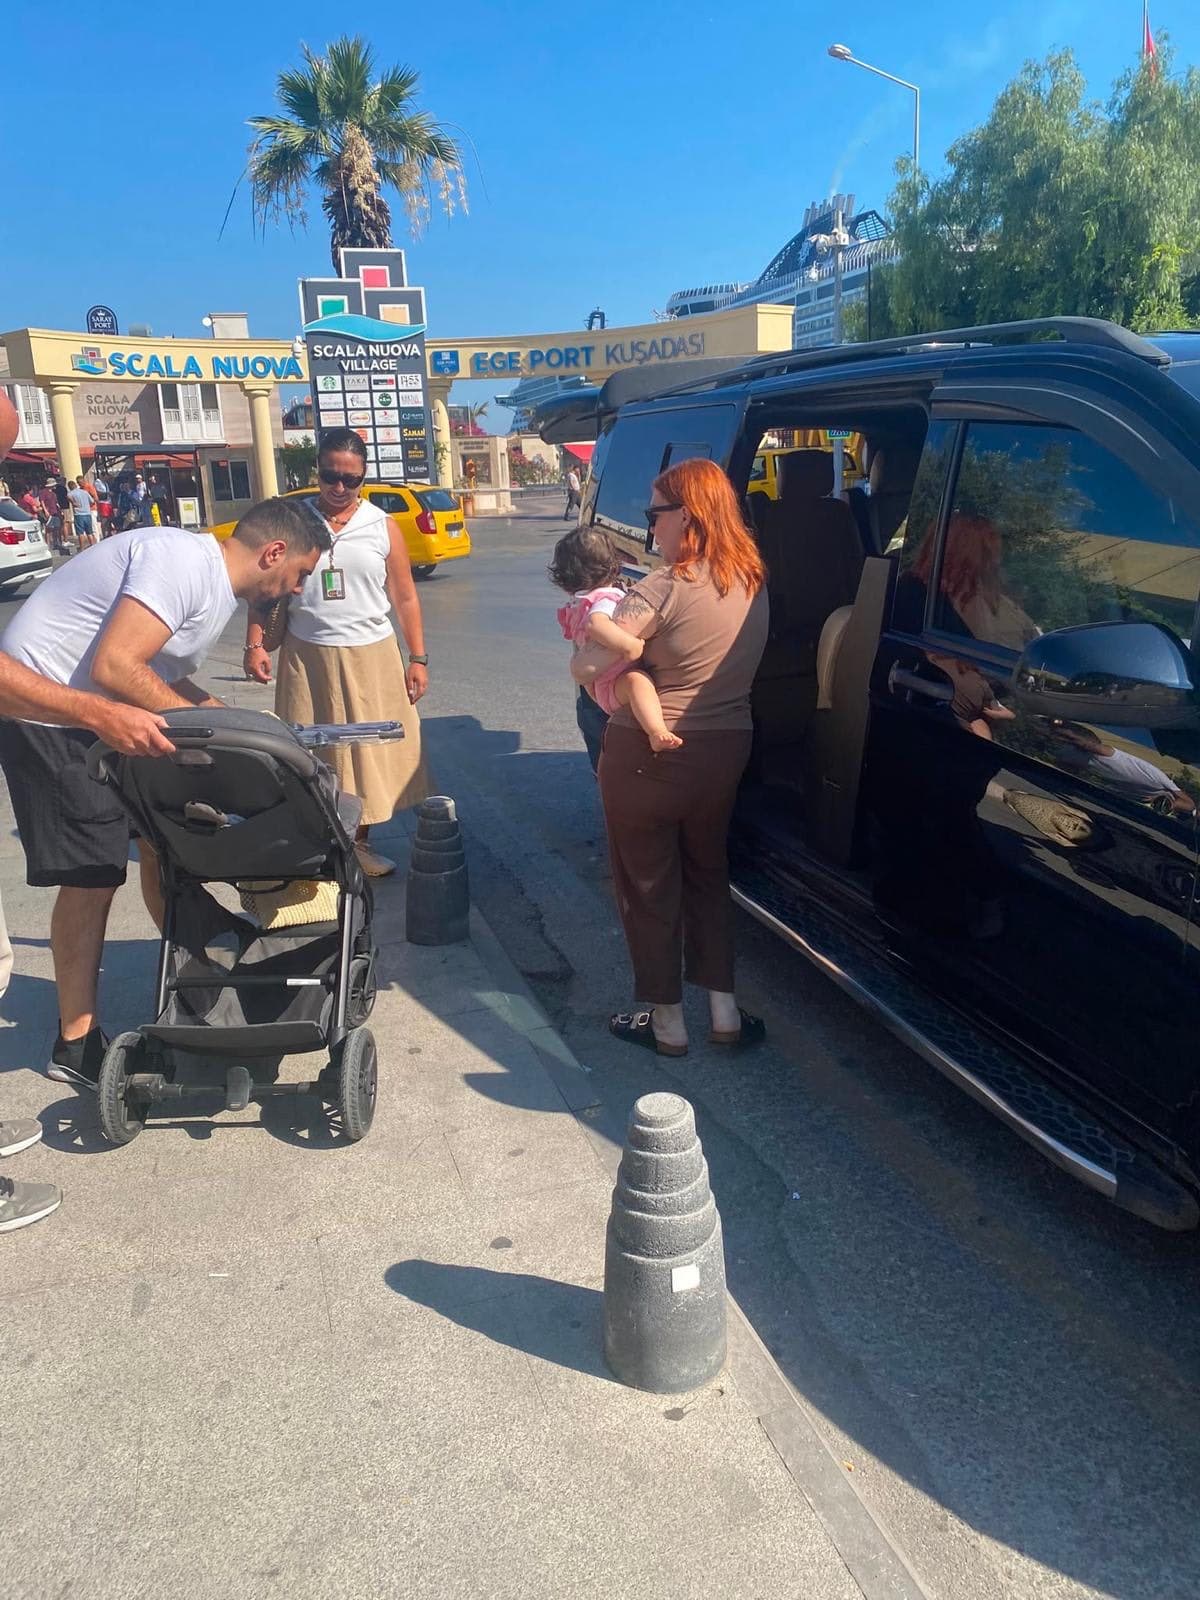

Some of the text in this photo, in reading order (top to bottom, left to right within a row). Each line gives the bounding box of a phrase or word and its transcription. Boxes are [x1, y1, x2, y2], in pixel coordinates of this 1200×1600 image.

[313, 343, 421, 358] SCALA NUOVA
[108, 352, 304, 379] SCALA NUOVA
[340, 359, 398, 371] VILLAGE
[474, 352, 520, 373] EGE
[529, 345, 595, 369] PORT
[86, 394, 130, 405] SCALA
[88, 405, 132, 415] NUOVA
[104, 416, 130, 430] art
[89, 431, 141, 441] CENTER
